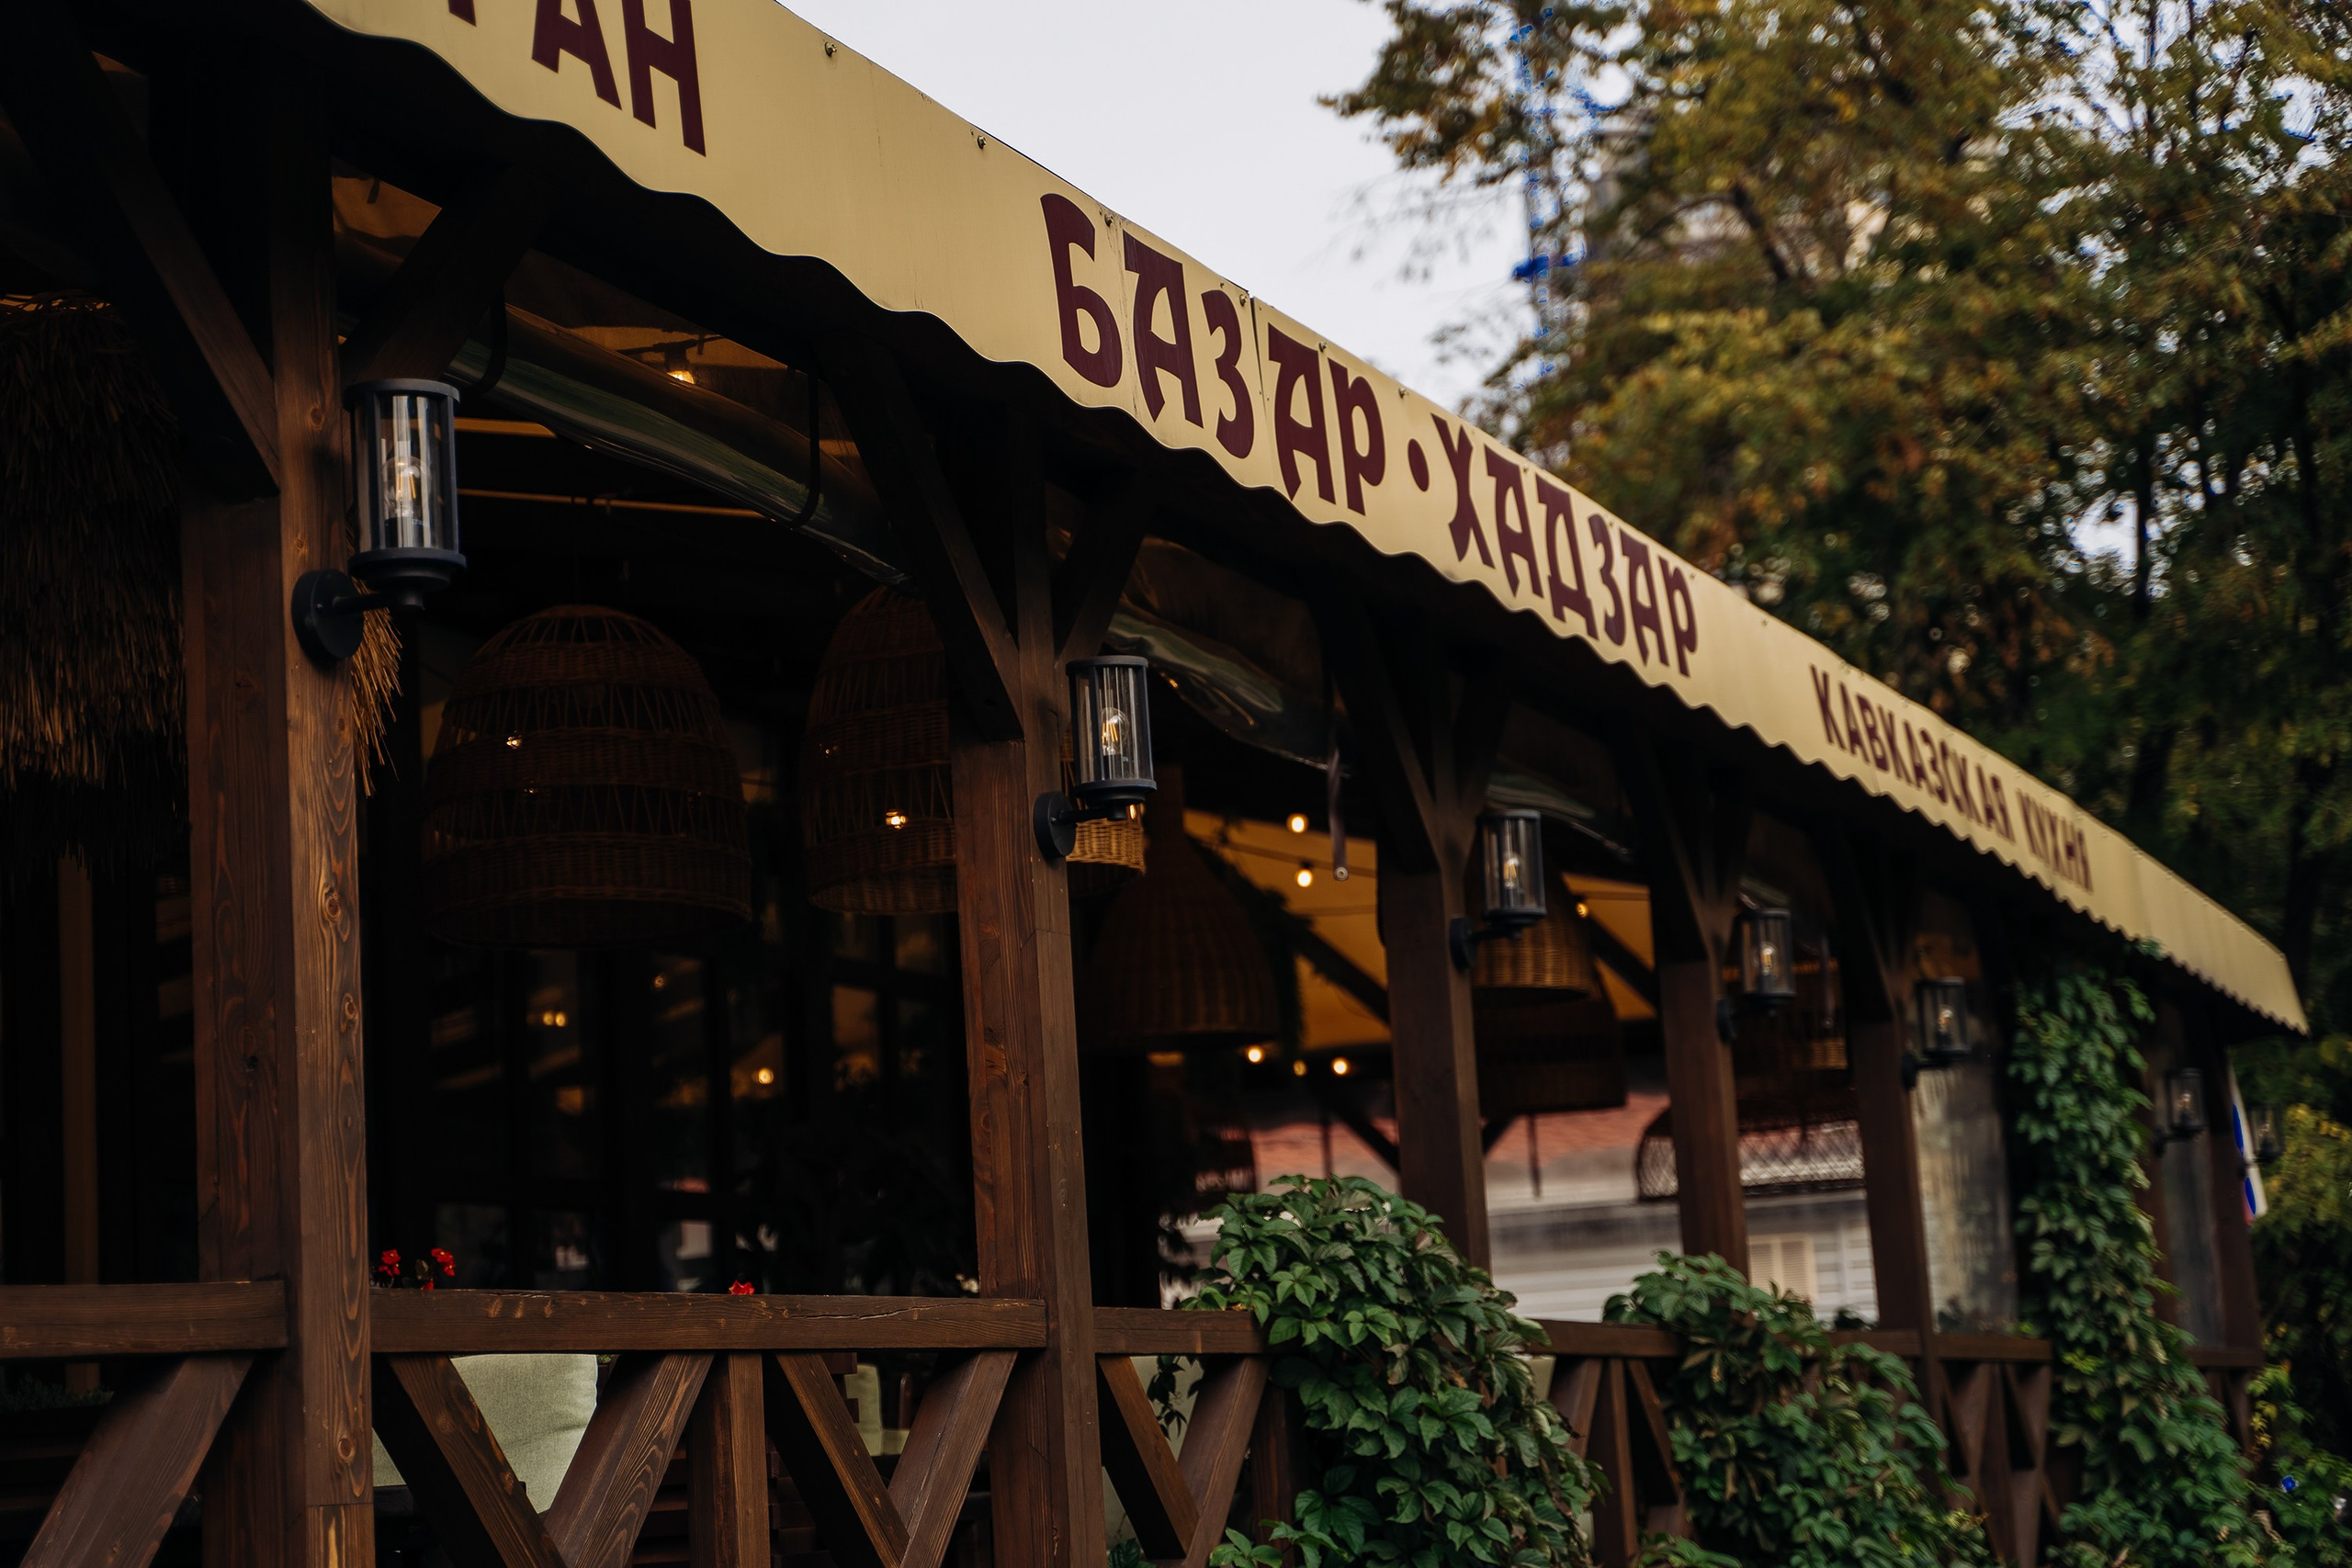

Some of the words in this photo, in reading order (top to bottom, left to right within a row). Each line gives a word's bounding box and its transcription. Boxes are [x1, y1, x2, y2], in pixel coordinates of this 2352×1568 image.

[447, 0, 707, 157] АН
[1040, 193, 1385, 515] БАЗАР
[1430, 412, 1698, 677] ХАДЗАР
[1810, 663, 2016, 843] КАВКАЗСКАЯ
